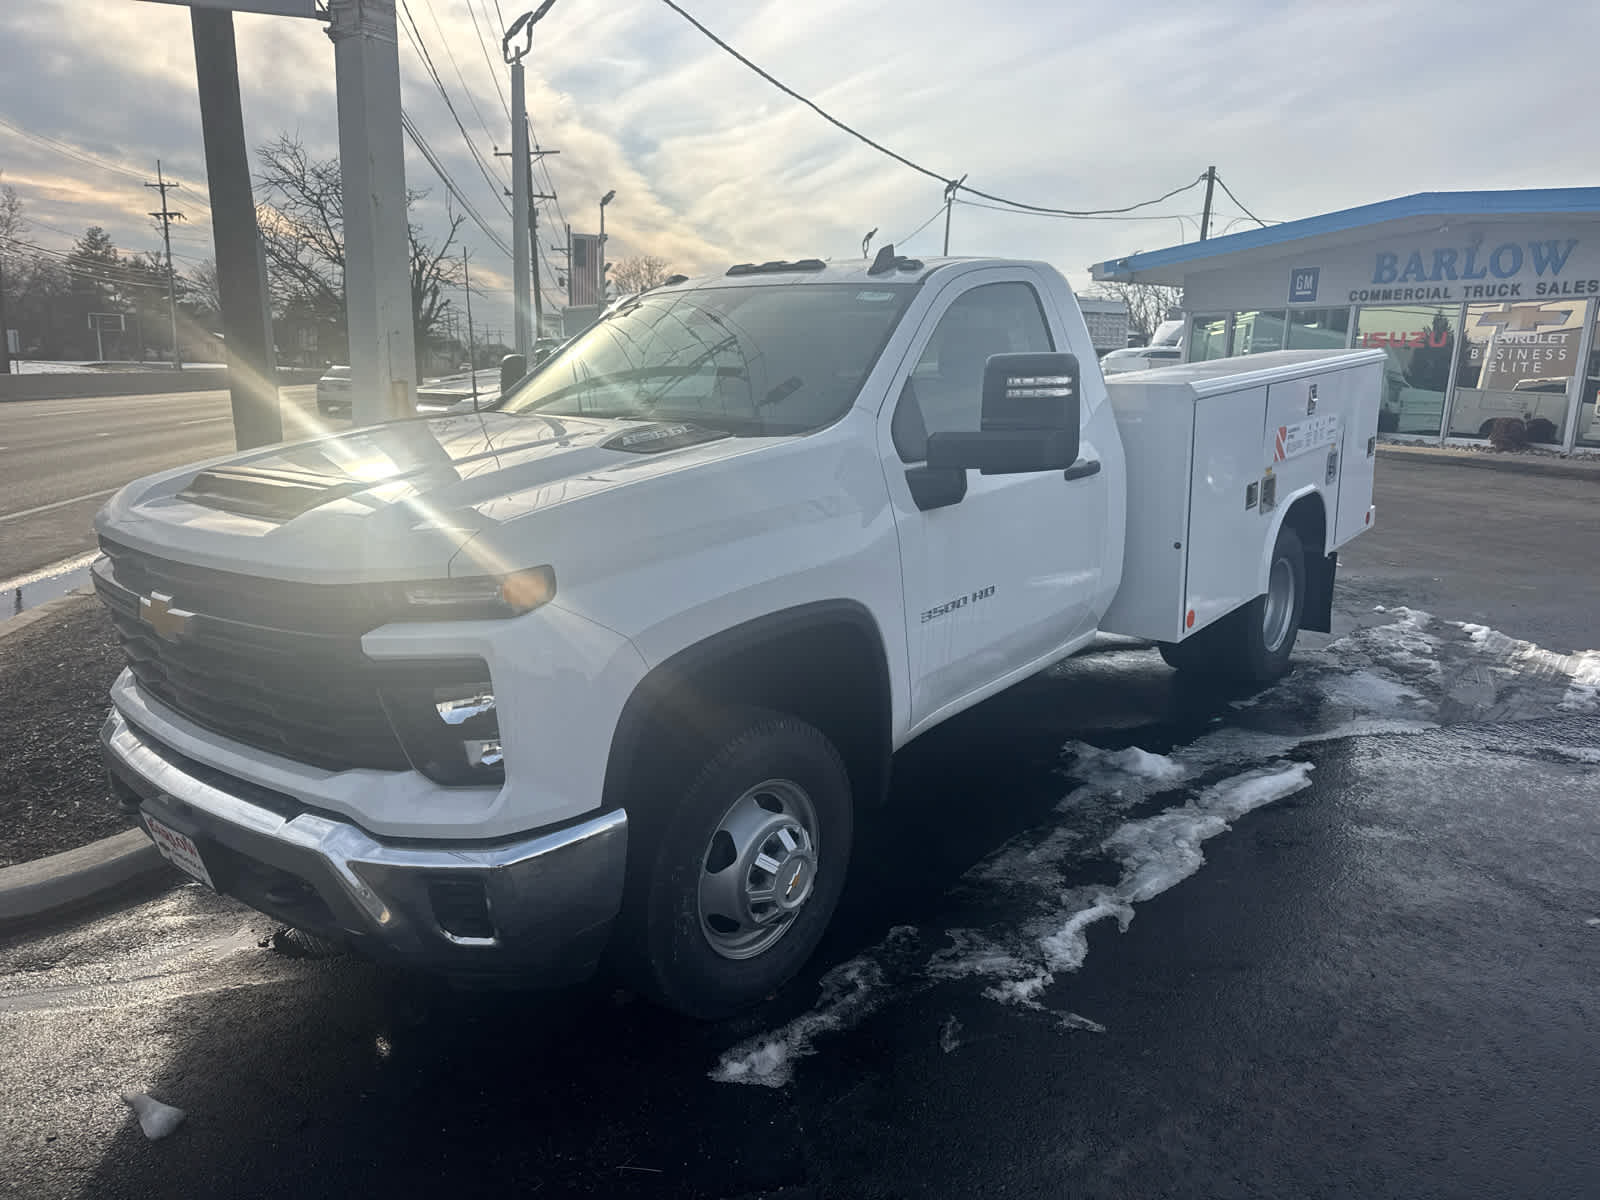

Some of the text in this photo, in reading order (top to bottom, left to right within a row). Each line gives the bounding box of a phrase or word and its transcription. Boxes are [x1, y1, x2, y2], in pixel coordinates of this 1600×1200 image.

[1371, 239, 1579, 285] BARLOW
[1295, 274, 1313, 290] GM
[1348, 279, 1600, 302] COMMERCIAL TRUCK SALES
[1361, 331, 1448, 349] ISUZU
[1470, 348, 1568, 361] BSINESS
[1487, 361, 1543, 374] ELITE
[920, 584, 996, 624] 3500 HD
